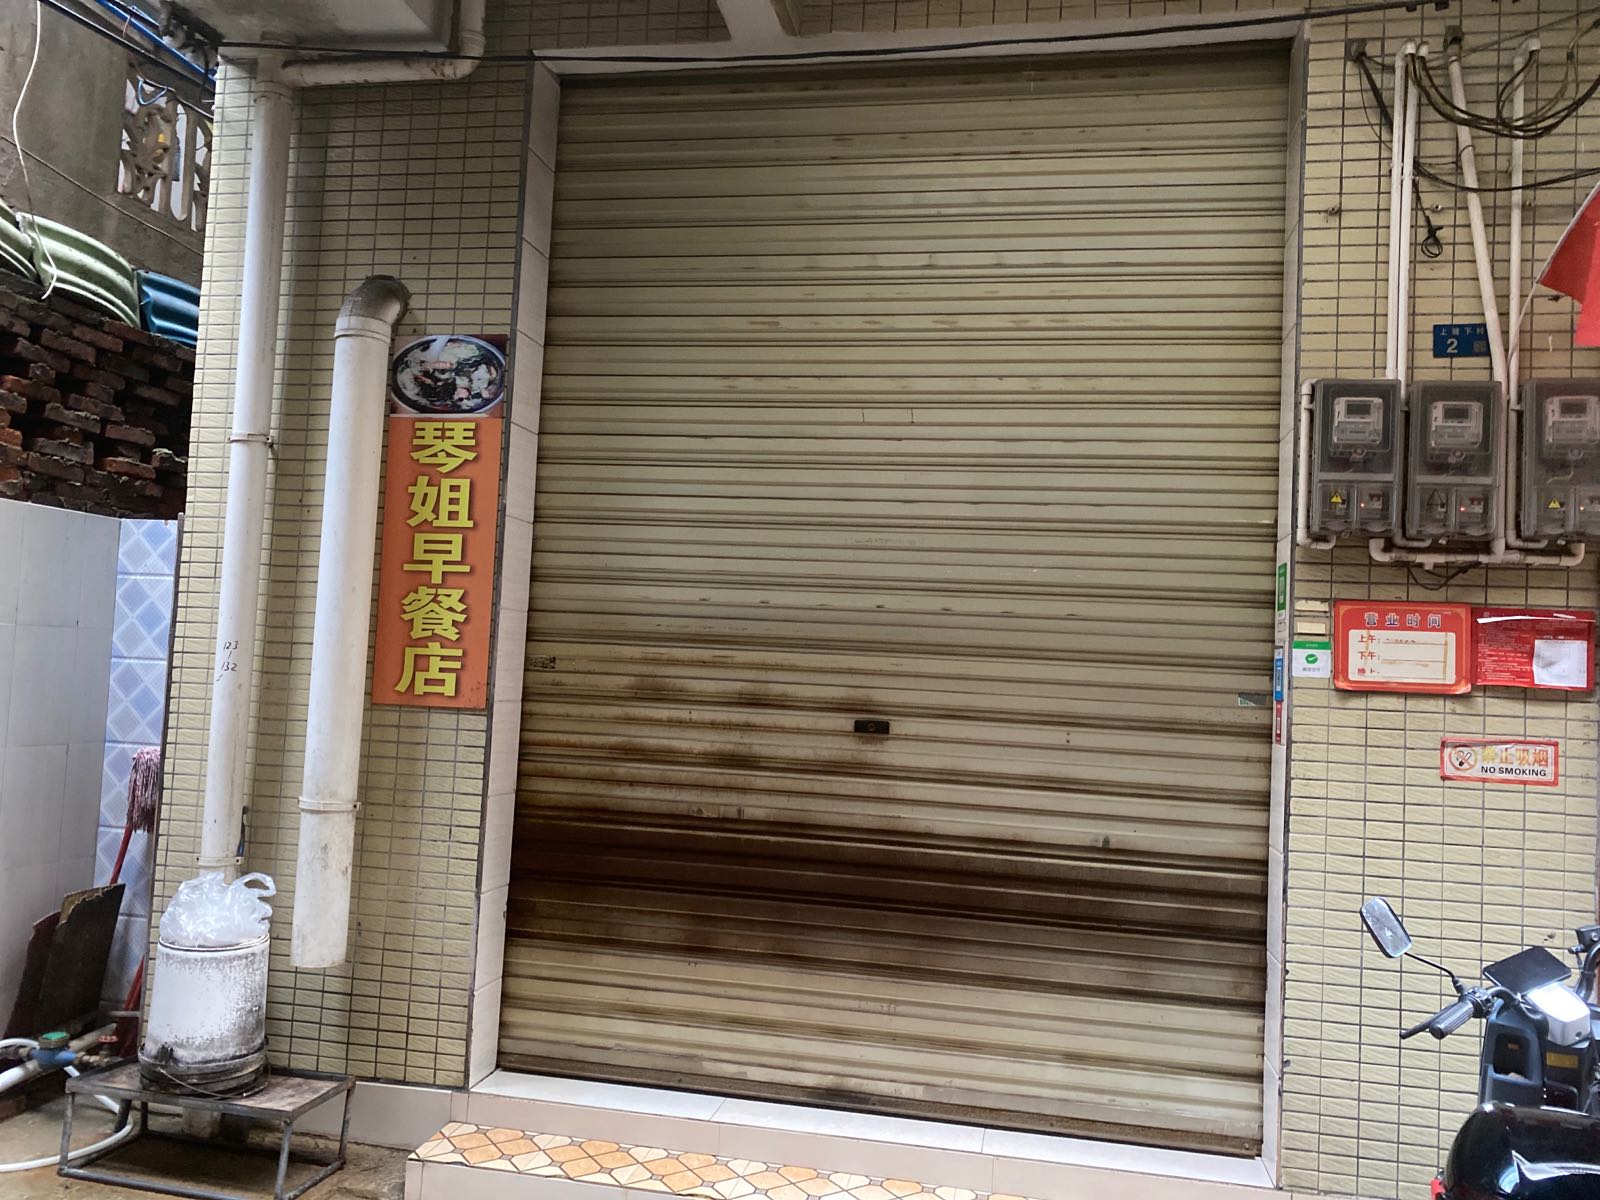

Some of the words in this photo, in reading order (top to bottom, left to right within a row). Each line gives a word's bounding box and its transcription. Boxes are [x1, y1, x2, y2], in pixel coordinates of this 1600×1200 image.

[1446, 338, 1458, 353] 2
[394, 421, 478, 697] 琴姐早餐店
[1364, 611, 1442, 629] 营业时间
[223, 640, 239, 650] 123
[221, 661, 238, 672] 132
[1481, 746, 1549, 768] 禁止吸烟
[1481, 766, 1496, 774] NO
[1498, 767, 1547, 777] SMOKING
